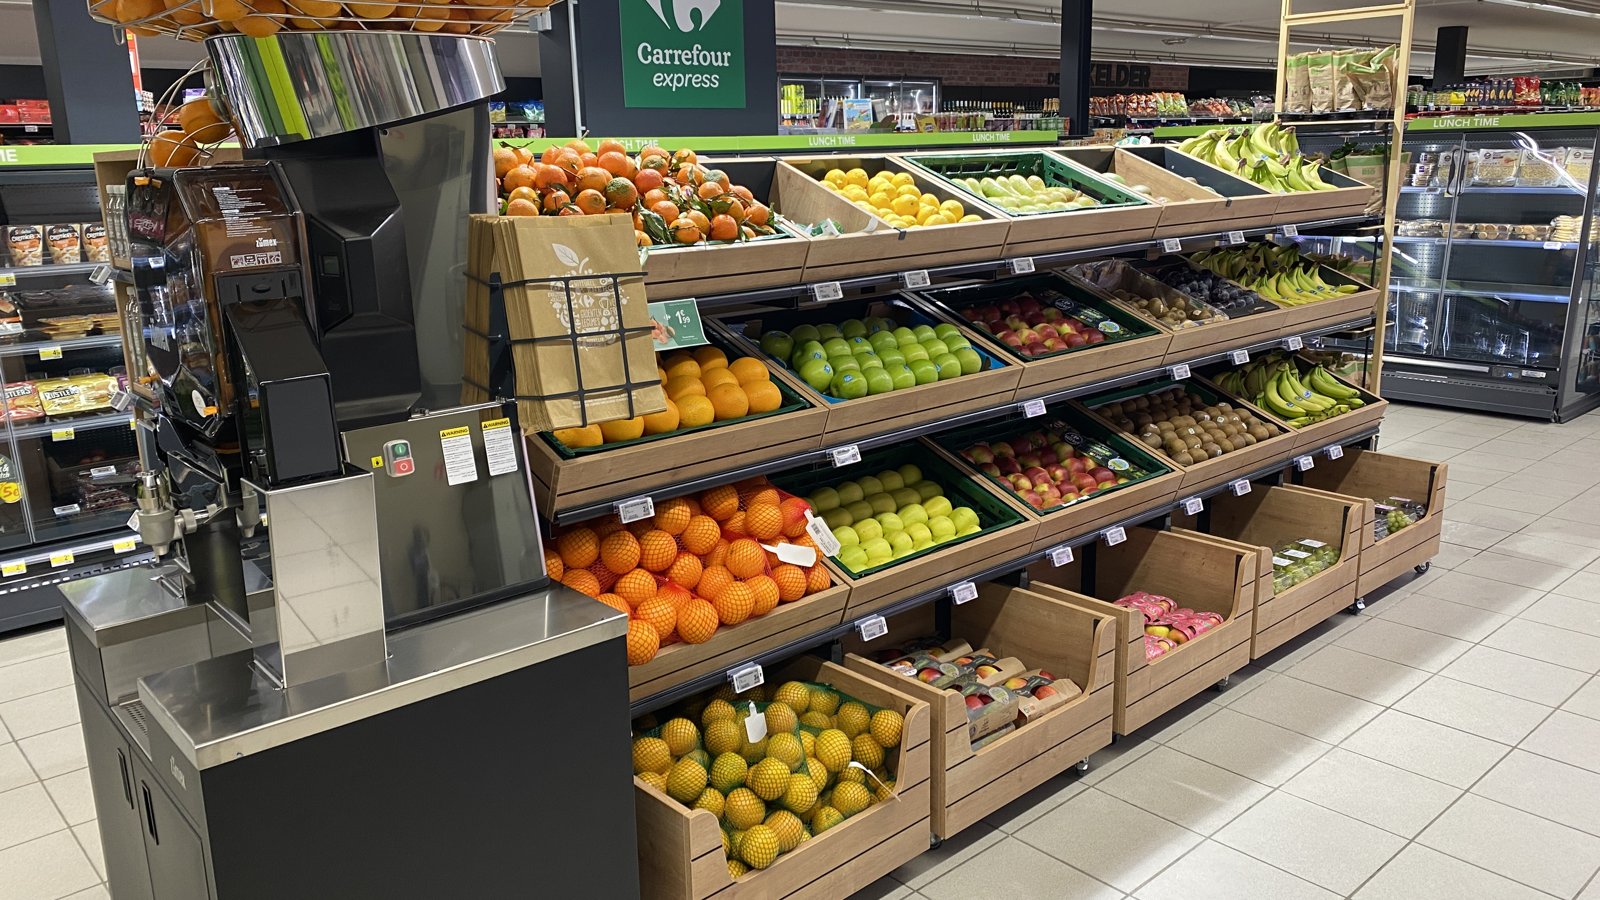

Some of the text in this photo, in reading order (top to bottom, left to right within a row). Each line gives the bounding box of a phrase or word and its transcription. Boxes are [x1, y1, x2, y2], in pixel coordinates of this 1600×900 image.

[637, 42, 732, 67] Carrefour
[652, 72, 720, 92] express
[1433, 117, 1500, 128] LUNCH TIME
[808, 136, 856, 146] LUNCH TIME
[972, 133, 1010, 142] LUNCH TIME
[487, 419, 509, 428] WARNING
[445, 428, 469, 436] WARNING
